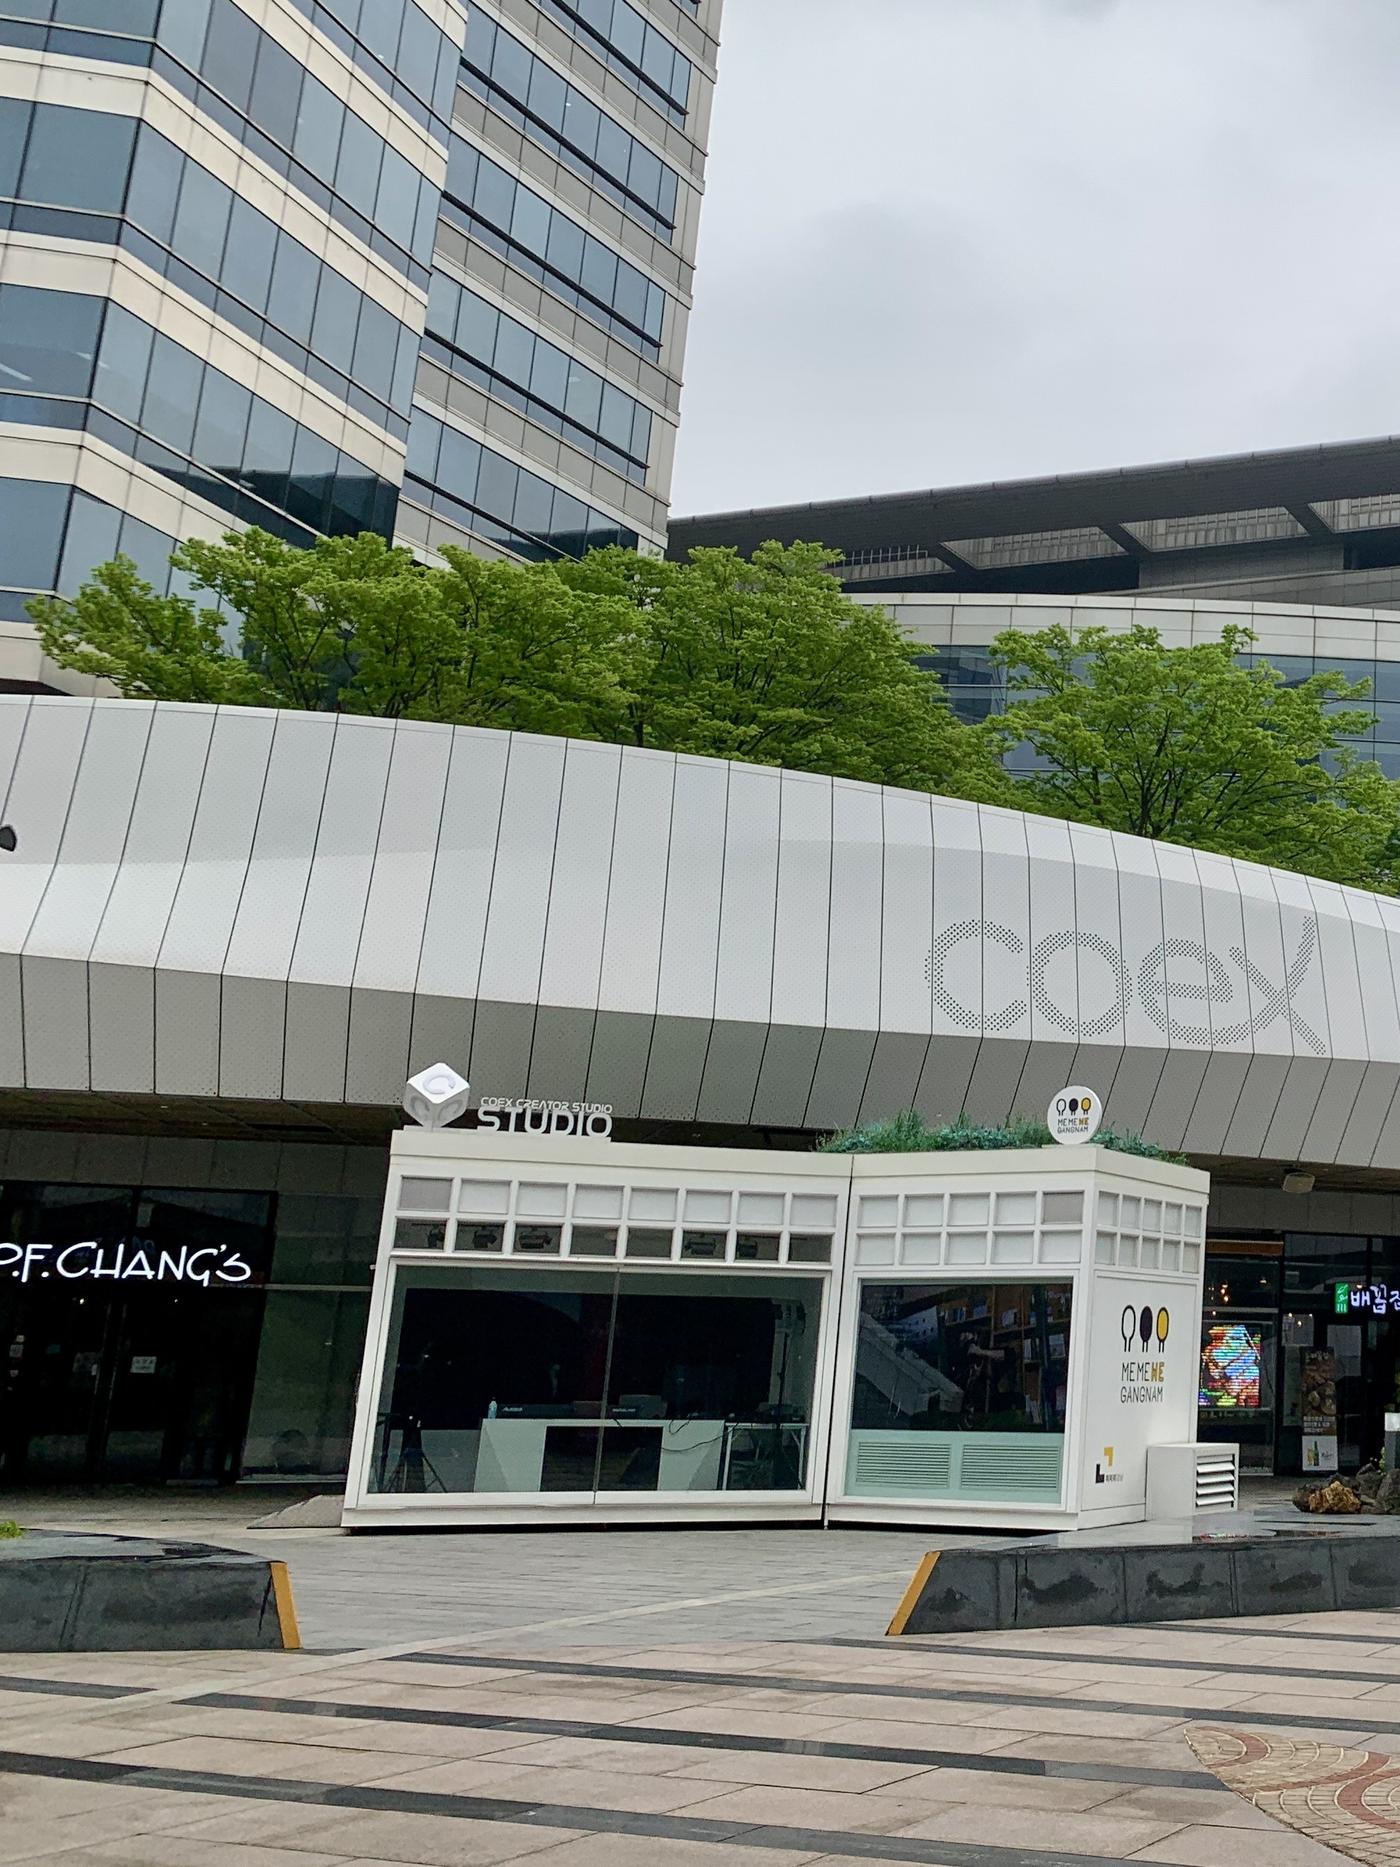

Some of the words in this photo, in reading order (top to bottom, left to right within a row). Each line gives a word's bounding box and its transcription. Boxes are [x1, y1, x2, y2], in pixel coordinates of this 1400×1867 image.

[480, 1096, 513, 1108] COEX
[515, 1099, 568, 1112] CREATOR
[571, 1102, 613, 1114] STUDIO
[477, 1106, 613, 1138] STUDIO
[1057, 1126, 1089, 1134] GANGNAM
[1120, 1386, 1163, 1403] GANGNAM
